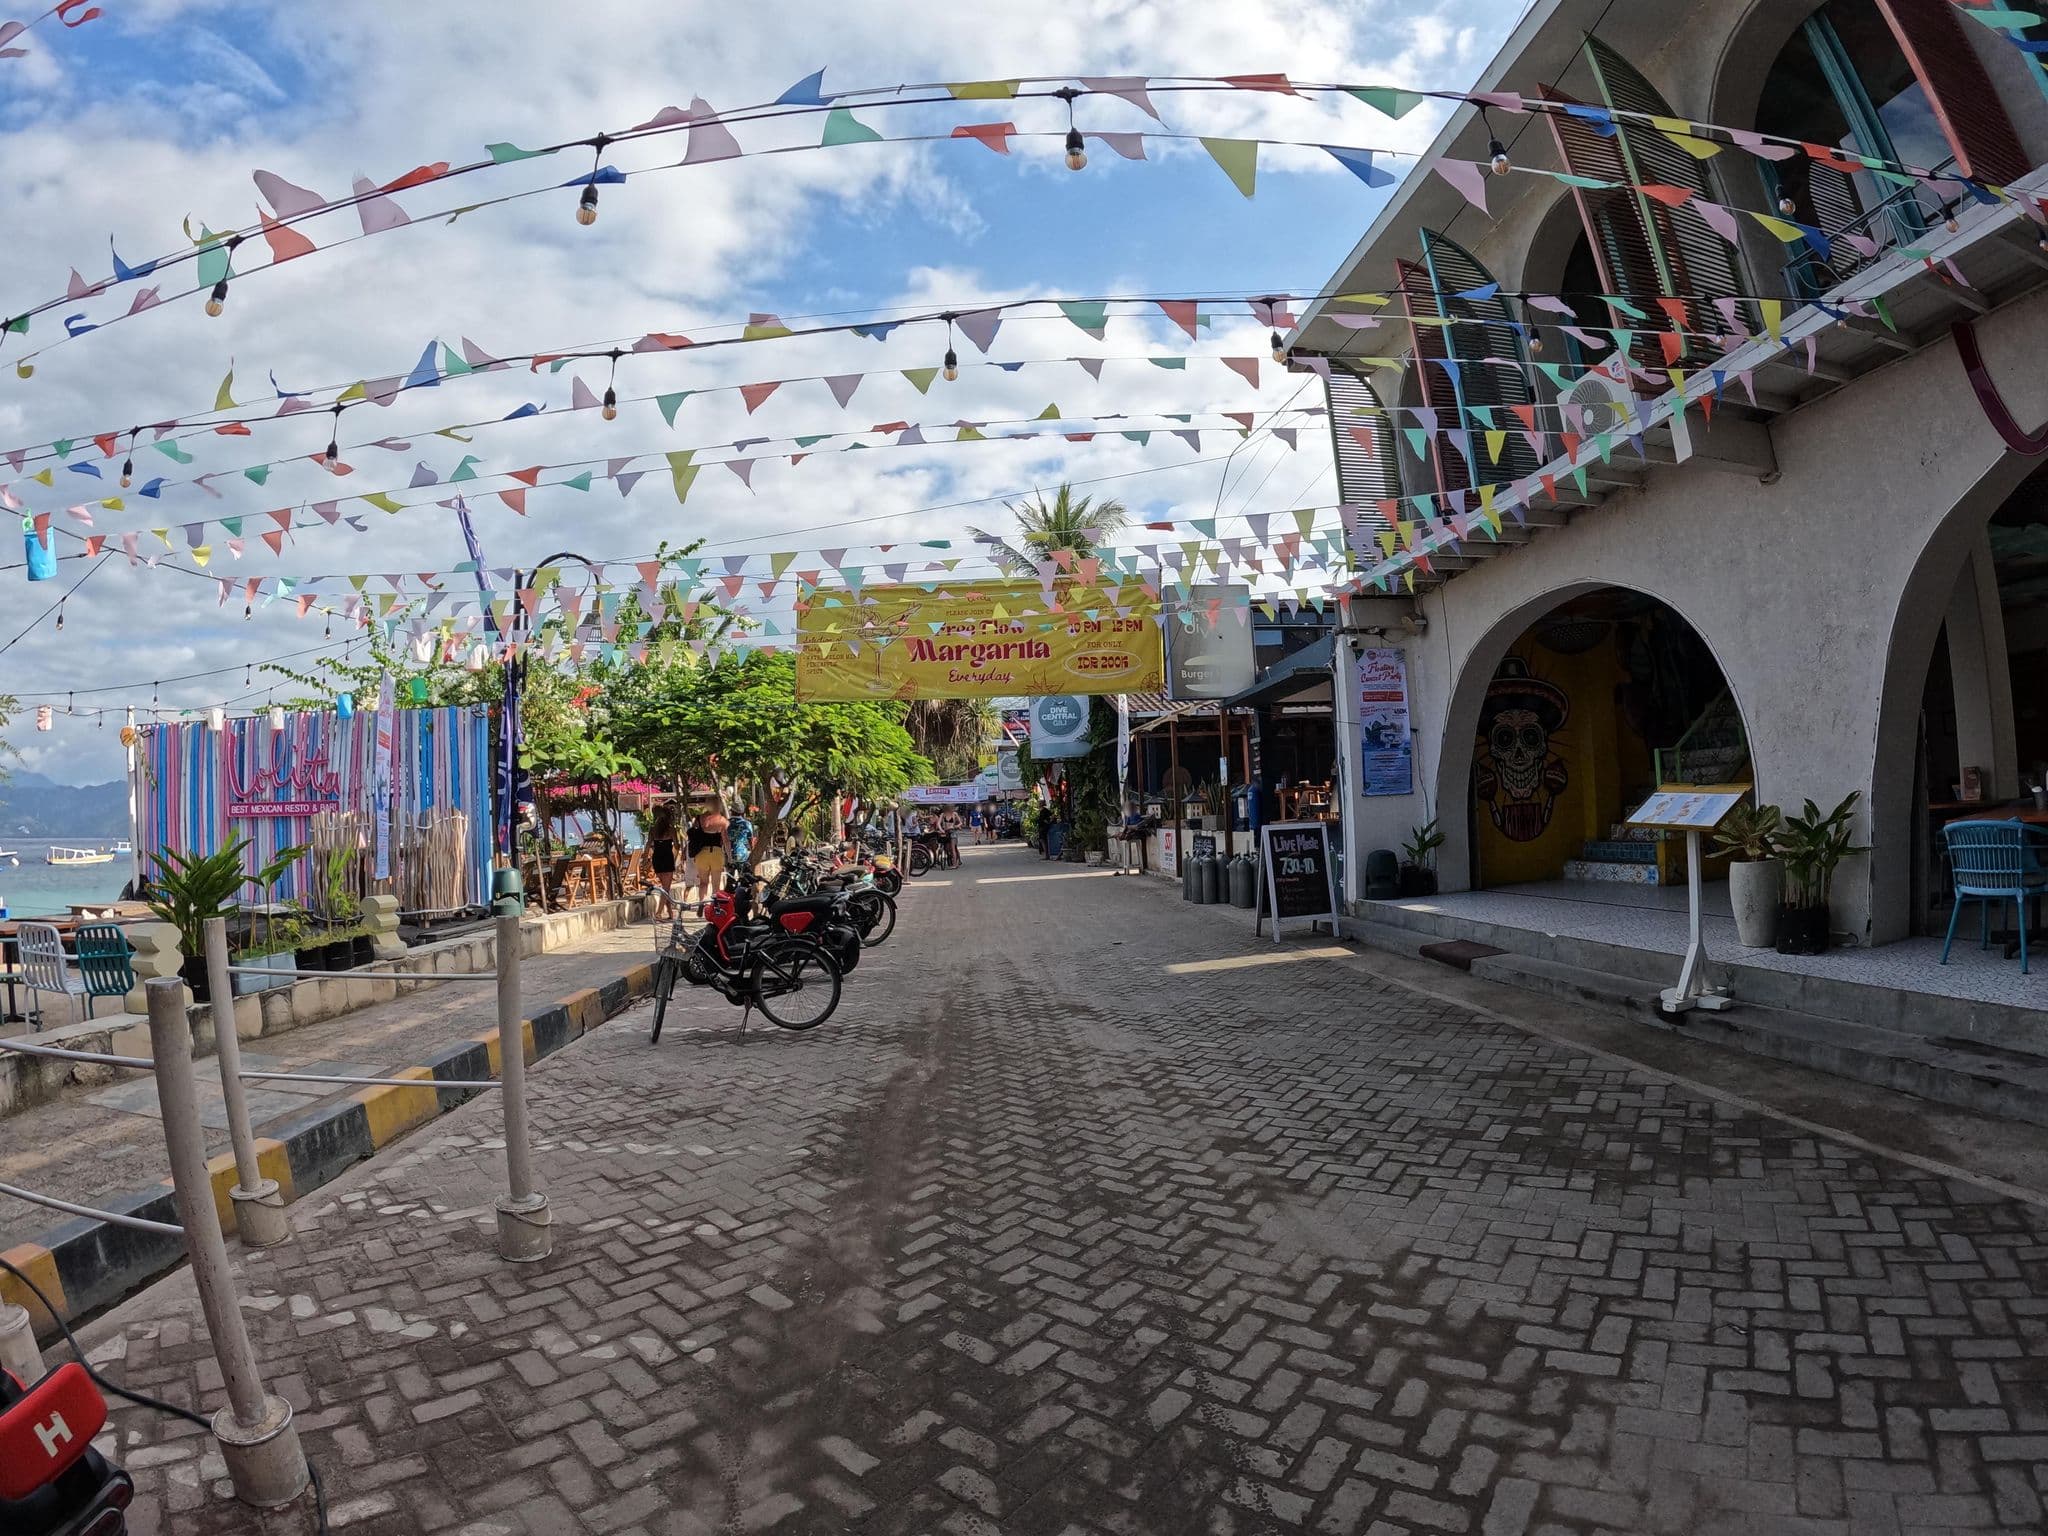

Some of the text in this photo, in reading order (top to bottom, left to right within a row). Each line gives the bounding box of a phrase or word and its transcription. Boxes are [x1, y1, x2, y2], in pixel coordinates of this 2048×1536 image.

[1084, 620, 1102, 633] PM
[1112, 620, 1123, 632] 12
[1126, 619, 1143, 632] PM
[1087, 640, 1122, 649] FOR ONLY
[911, 638, 1051, 668] Margarita
[1077, 656, 1098, 669] IDR
[948, 667, 1011, 685] Everyday
[1050, 706, 1069, 714] DIVE
[1041, 712, 1077, 721] CENTRAL
[231, 805, 248, 814] BEST
[251, 804, 283, 814] MEXICAN
[285, 803, 310, 814] RESTO
[312, 803, 318, 813] &
